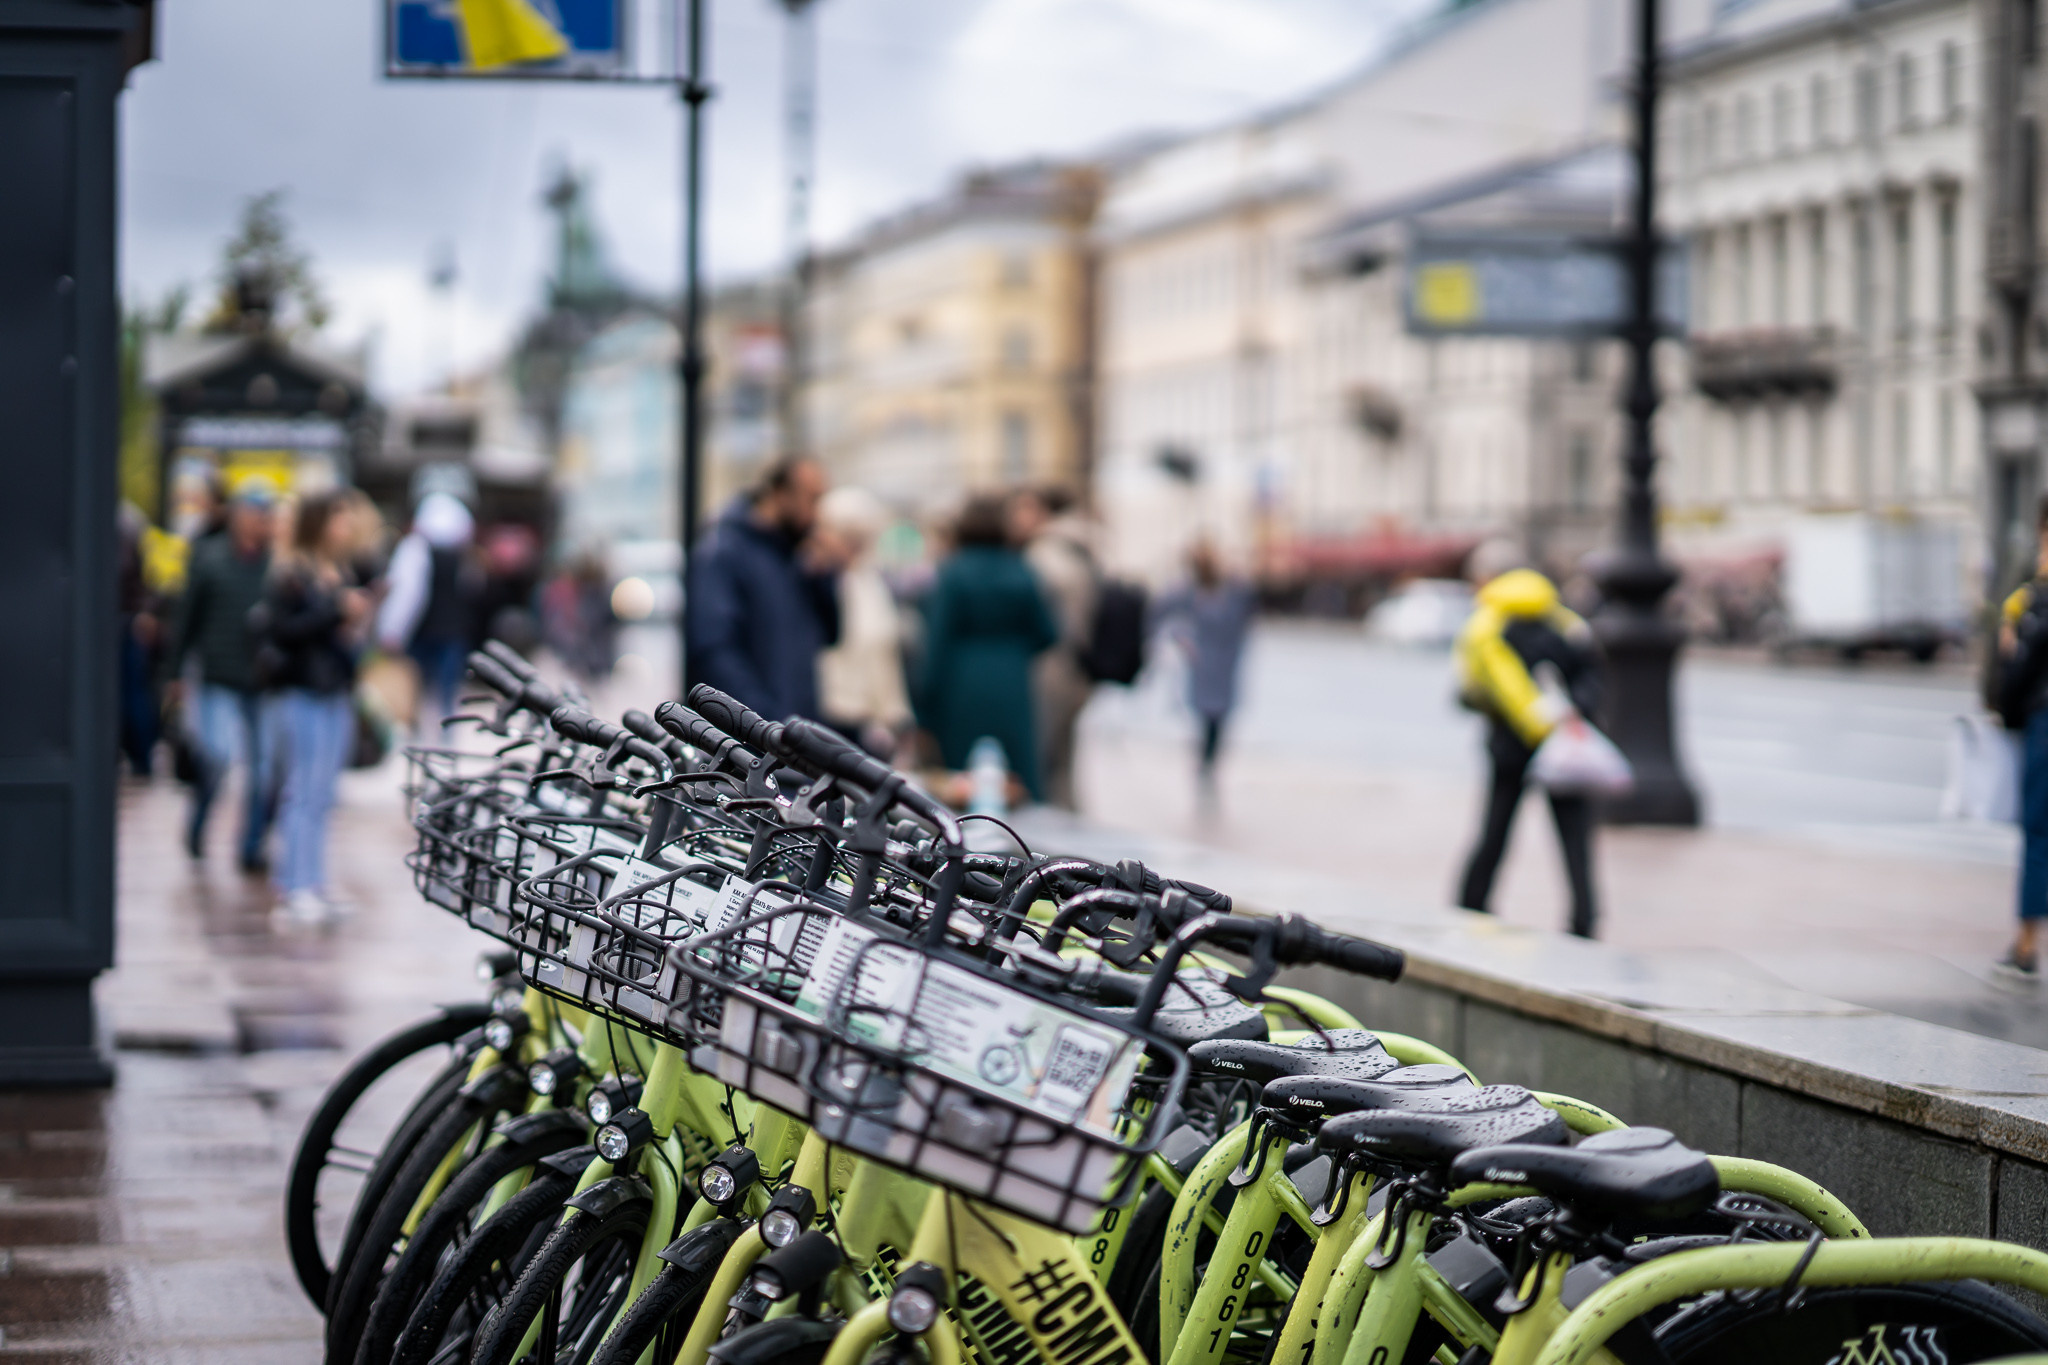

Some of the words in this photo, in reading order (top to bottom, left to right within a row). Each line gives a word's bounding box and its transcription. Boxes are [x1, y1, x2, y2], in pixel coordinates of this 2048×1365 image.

[1220, 1060, 1245, 1070] VELO
[1299, 1098, 1325, 1108] VELO
[1091, 1207, 1120, 1280] 08
[1208, 1230, 1264, 1354] 0861
